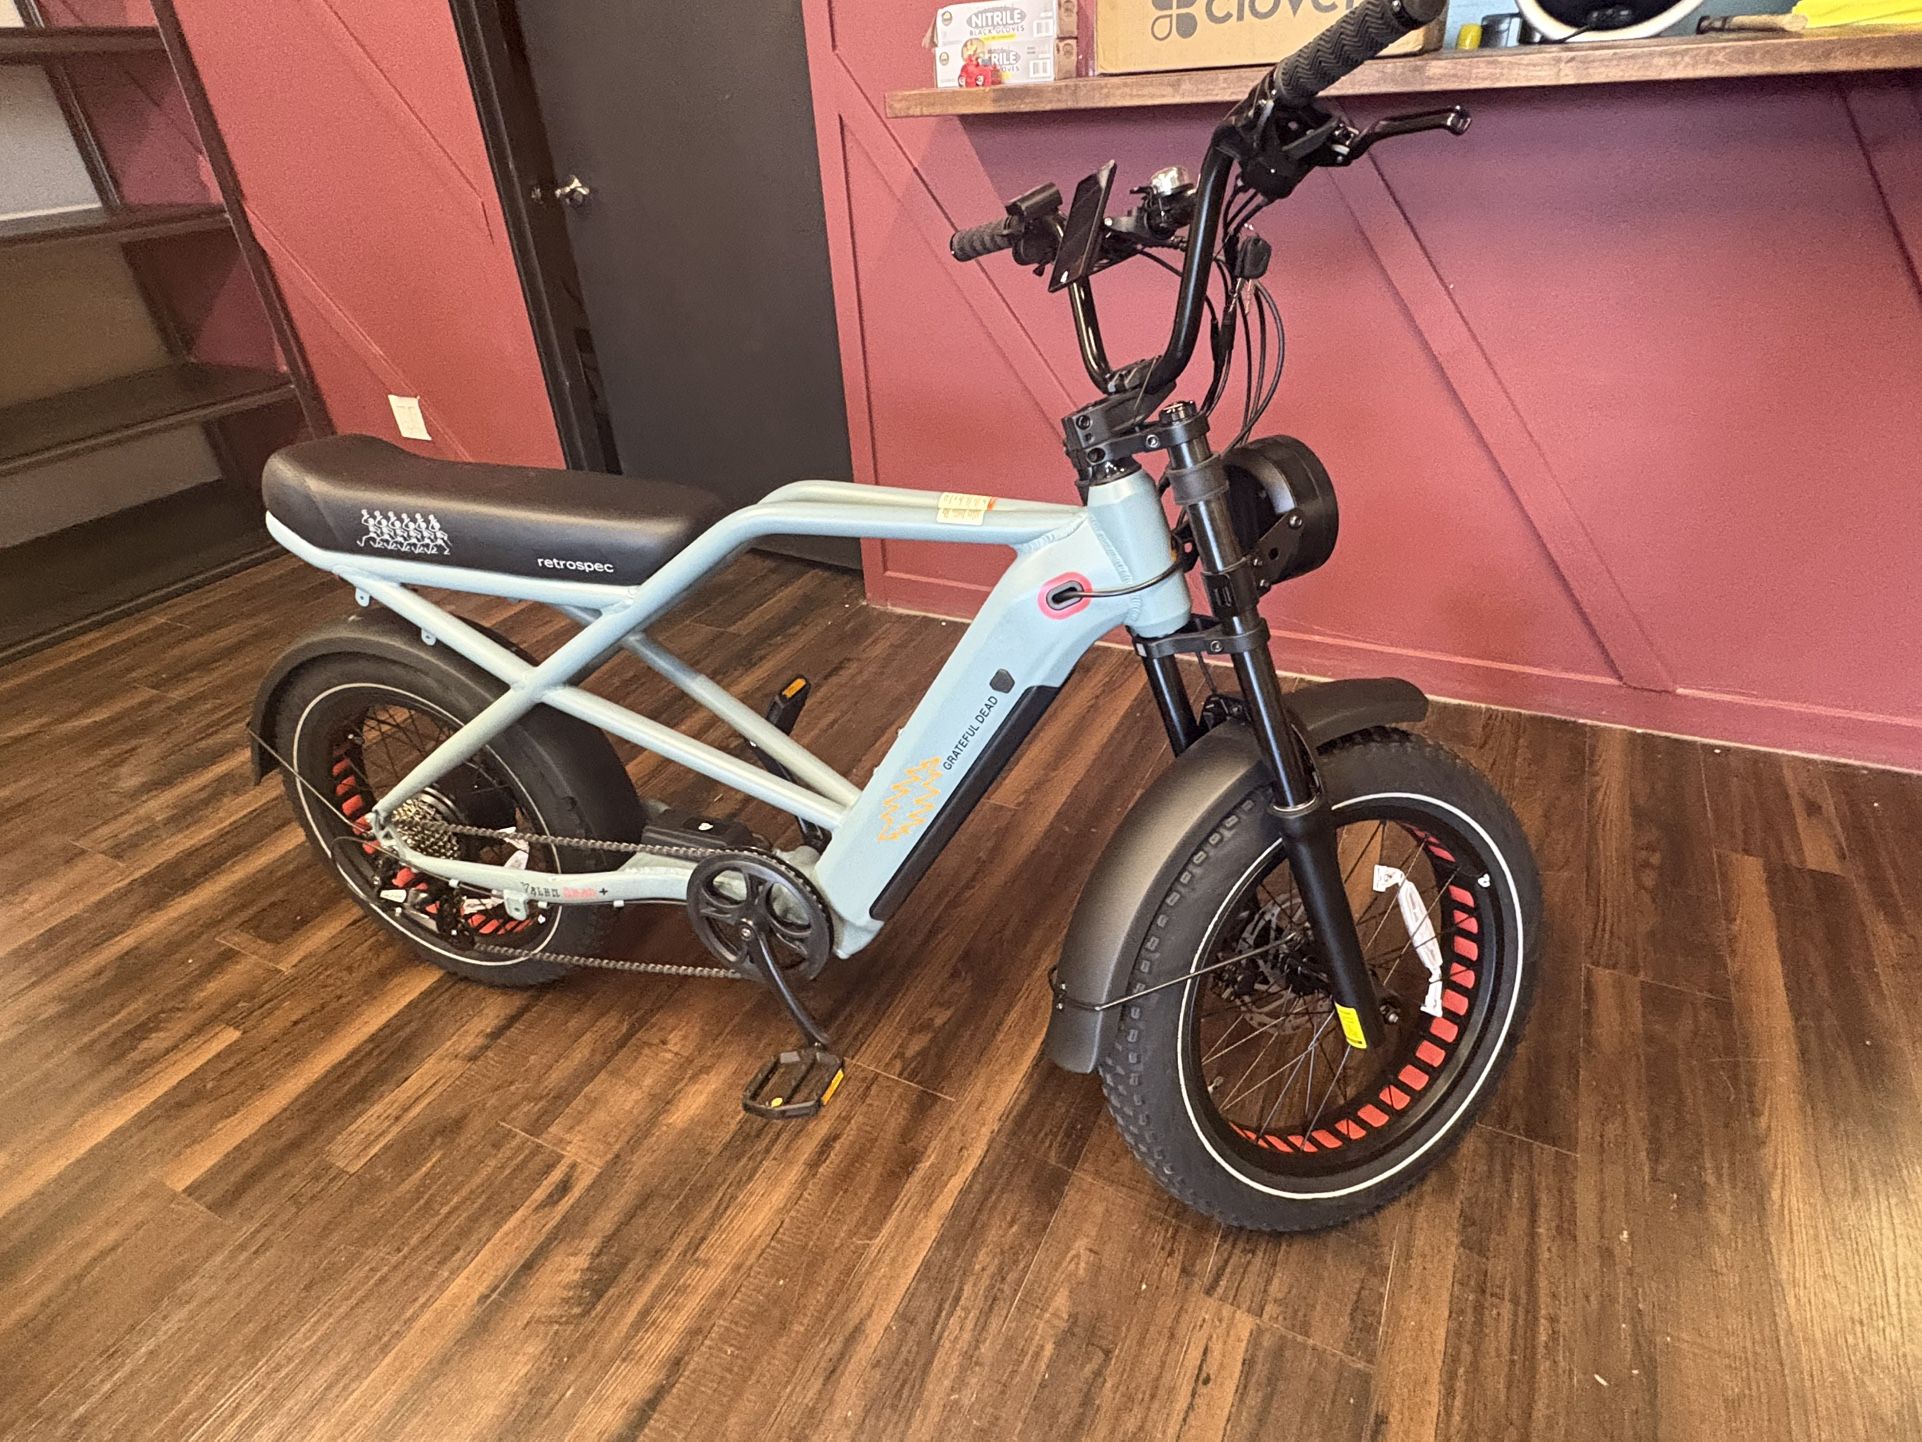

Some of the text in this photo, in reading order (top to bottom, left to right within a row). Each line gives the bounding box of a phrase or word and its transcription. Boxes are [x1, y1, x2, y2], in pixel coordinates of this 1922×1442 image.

[971, 10, 1022, 27] NITRILE
[1205, 0, 1354, 24] clov
[969, 25, 1025, 36] BLACK GLOVES
[990, 51, 1018, 65] RILE
[537, 558, 614, 573] retrospec
[943, 696, 998, 770] GRATEFUL DEAD
